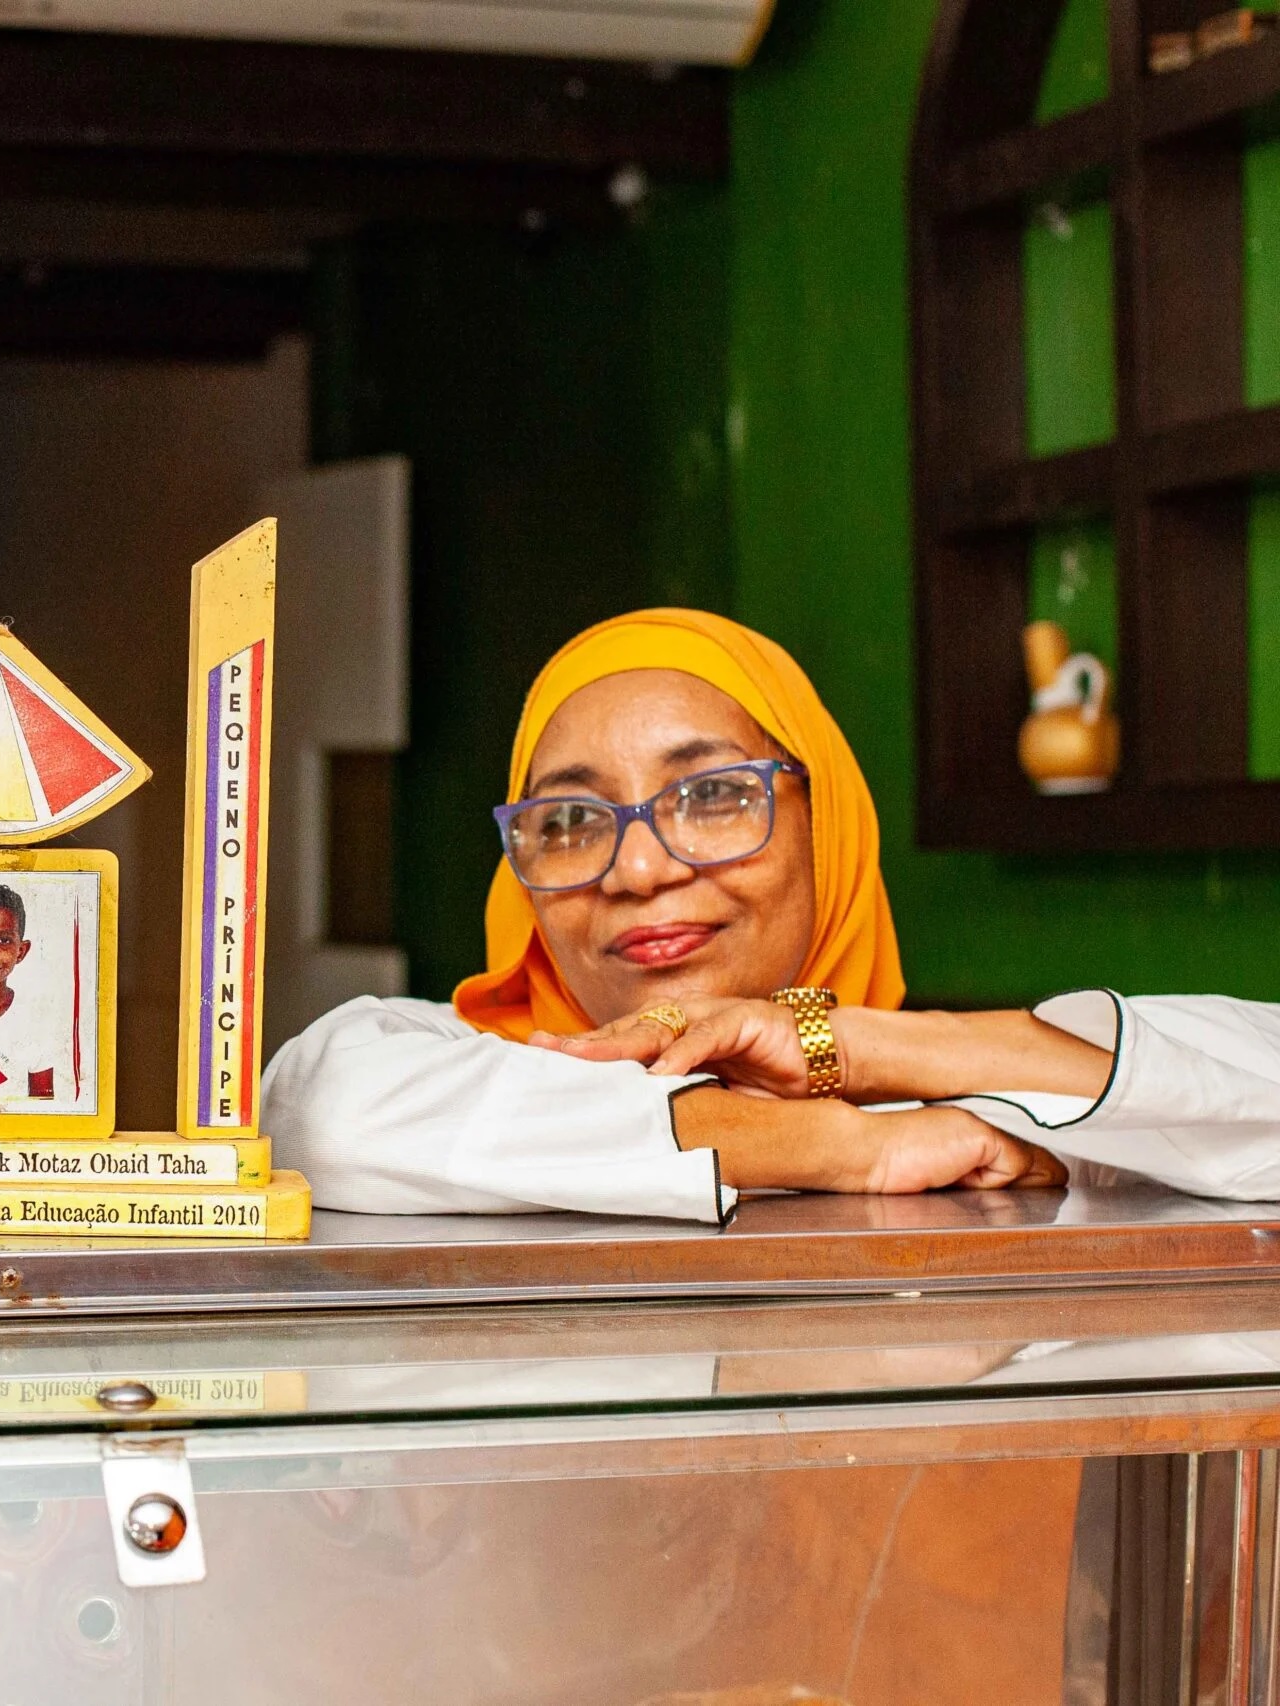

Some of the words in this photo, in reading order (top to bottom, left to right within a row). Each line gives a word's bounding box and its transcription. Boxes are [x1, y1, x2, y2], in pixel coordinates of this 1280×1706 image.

[222, 665, 244, 857] PEQUENO
[218, 896, 236, 1117] PRÍNCIPE
[19, 1152, 82, 1173] Motaz
[90, 1152, 149, 1174] Obaid
[158, 1153, 208, 1175] Taha
[21, 1200, 120, 1229] Educação
[128, 1203, 204, 1226] Infantil
[213, 1205, 260, 1226] 2010
